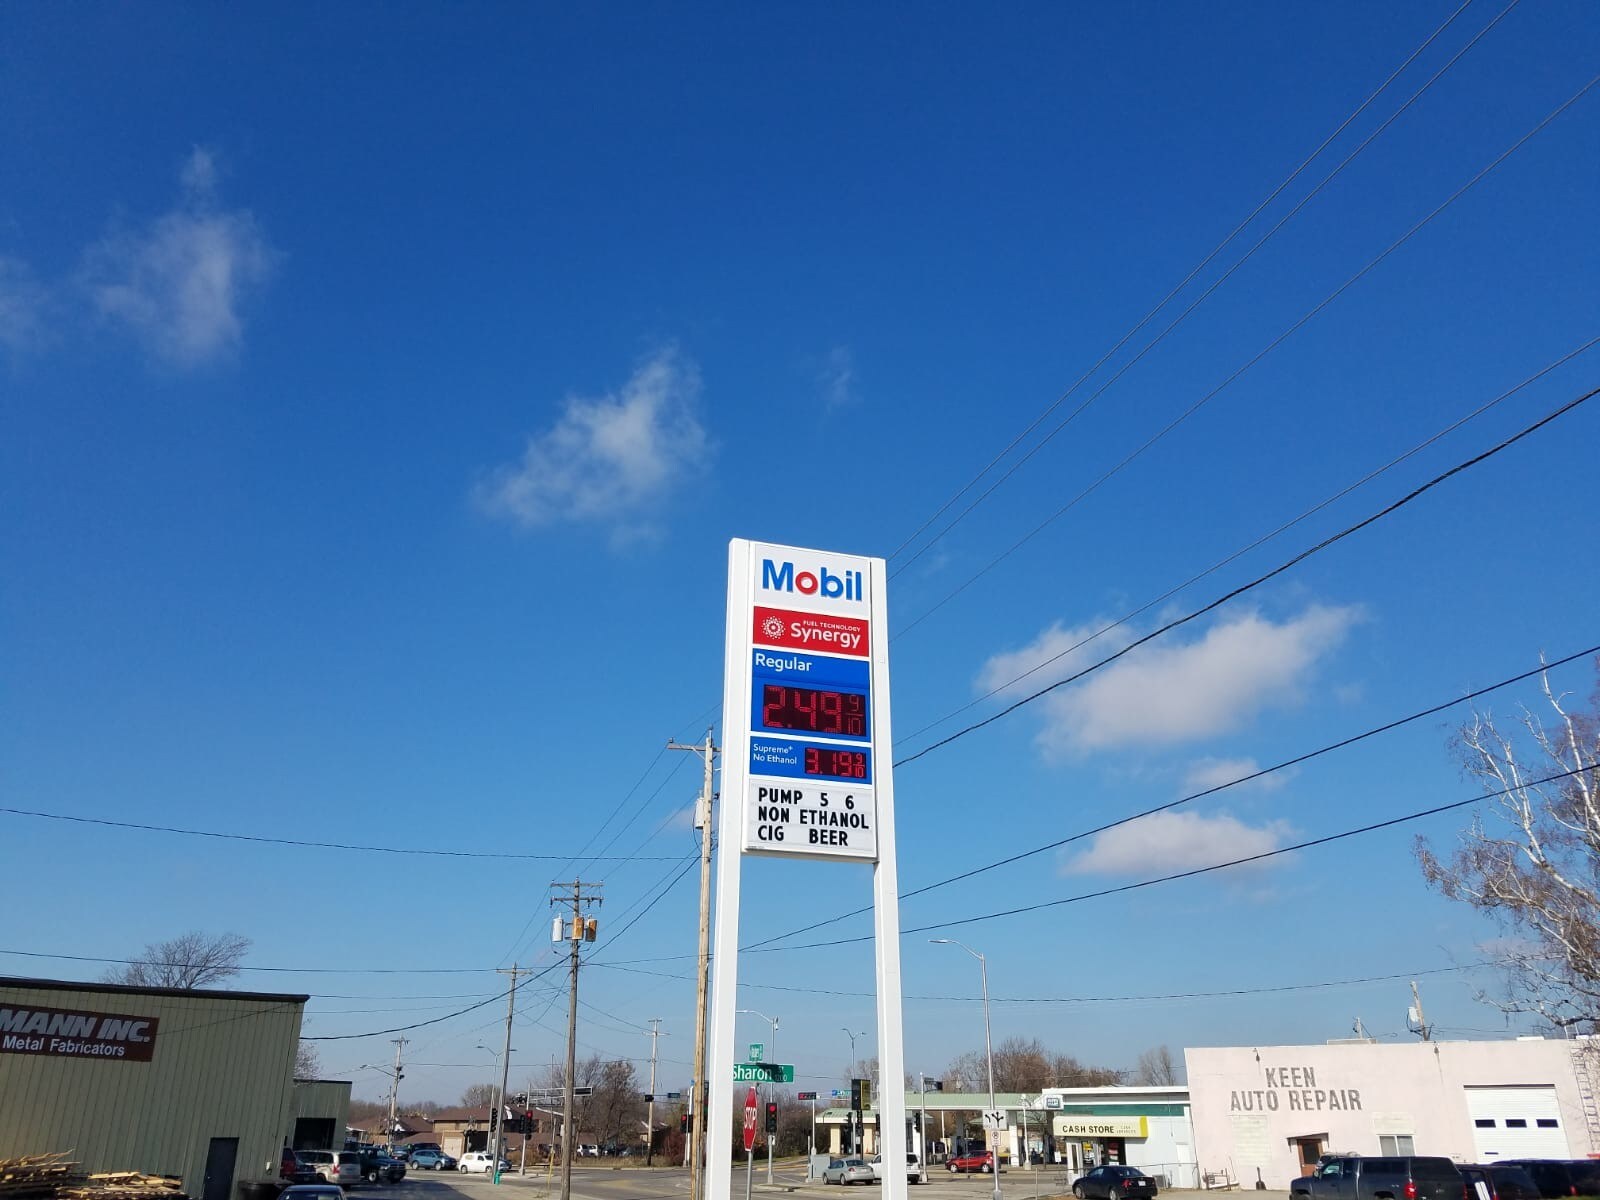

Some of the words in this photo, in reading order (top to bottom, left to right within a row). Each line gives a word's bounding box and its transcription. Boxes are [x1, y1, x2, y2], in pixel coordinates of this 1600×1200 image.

[762, 558, 863, 601] Mobil
[790, 622, 861, 649] Synergy
[820, 622, 861, 632] TECHNOLOGY
[755, 653, 812, 672] Regular
[763, 685, 842, 735] 2.49
[753, 753, 765, 762] No
[767, 755, 797, 765] Ethanol
[758, 787, 803, 805] PUMP
[820, 792, 829, 807] 5
[845, 795, 855, 810] 6
[758, 806, 790, 823] NON
[800, 809, 869, 830] ETHANOL
[757, 825, 785, 842] CIG
[809, 828, 849, 847] BEER
[0, 1009, 98, 1038] MANN
[96, 1018, 151, 1043] INC.
[2, 1035, 45, 1050] Metal
[49, 1038, 125, 1057] Fabricators
[733, 1065, 772, 1081] Sharon
[1265, 1067, 1317, 1088] KEEN
[1230, 1090, 1279, 1112] AUTO
[1288, 1089, 1363, 1111] REPAIR
[744, 1106, 757, 1130] STOP
[1062, 1125, 1086, 1134] CASH
[1088, 1125, 1115, 1134] STORE
